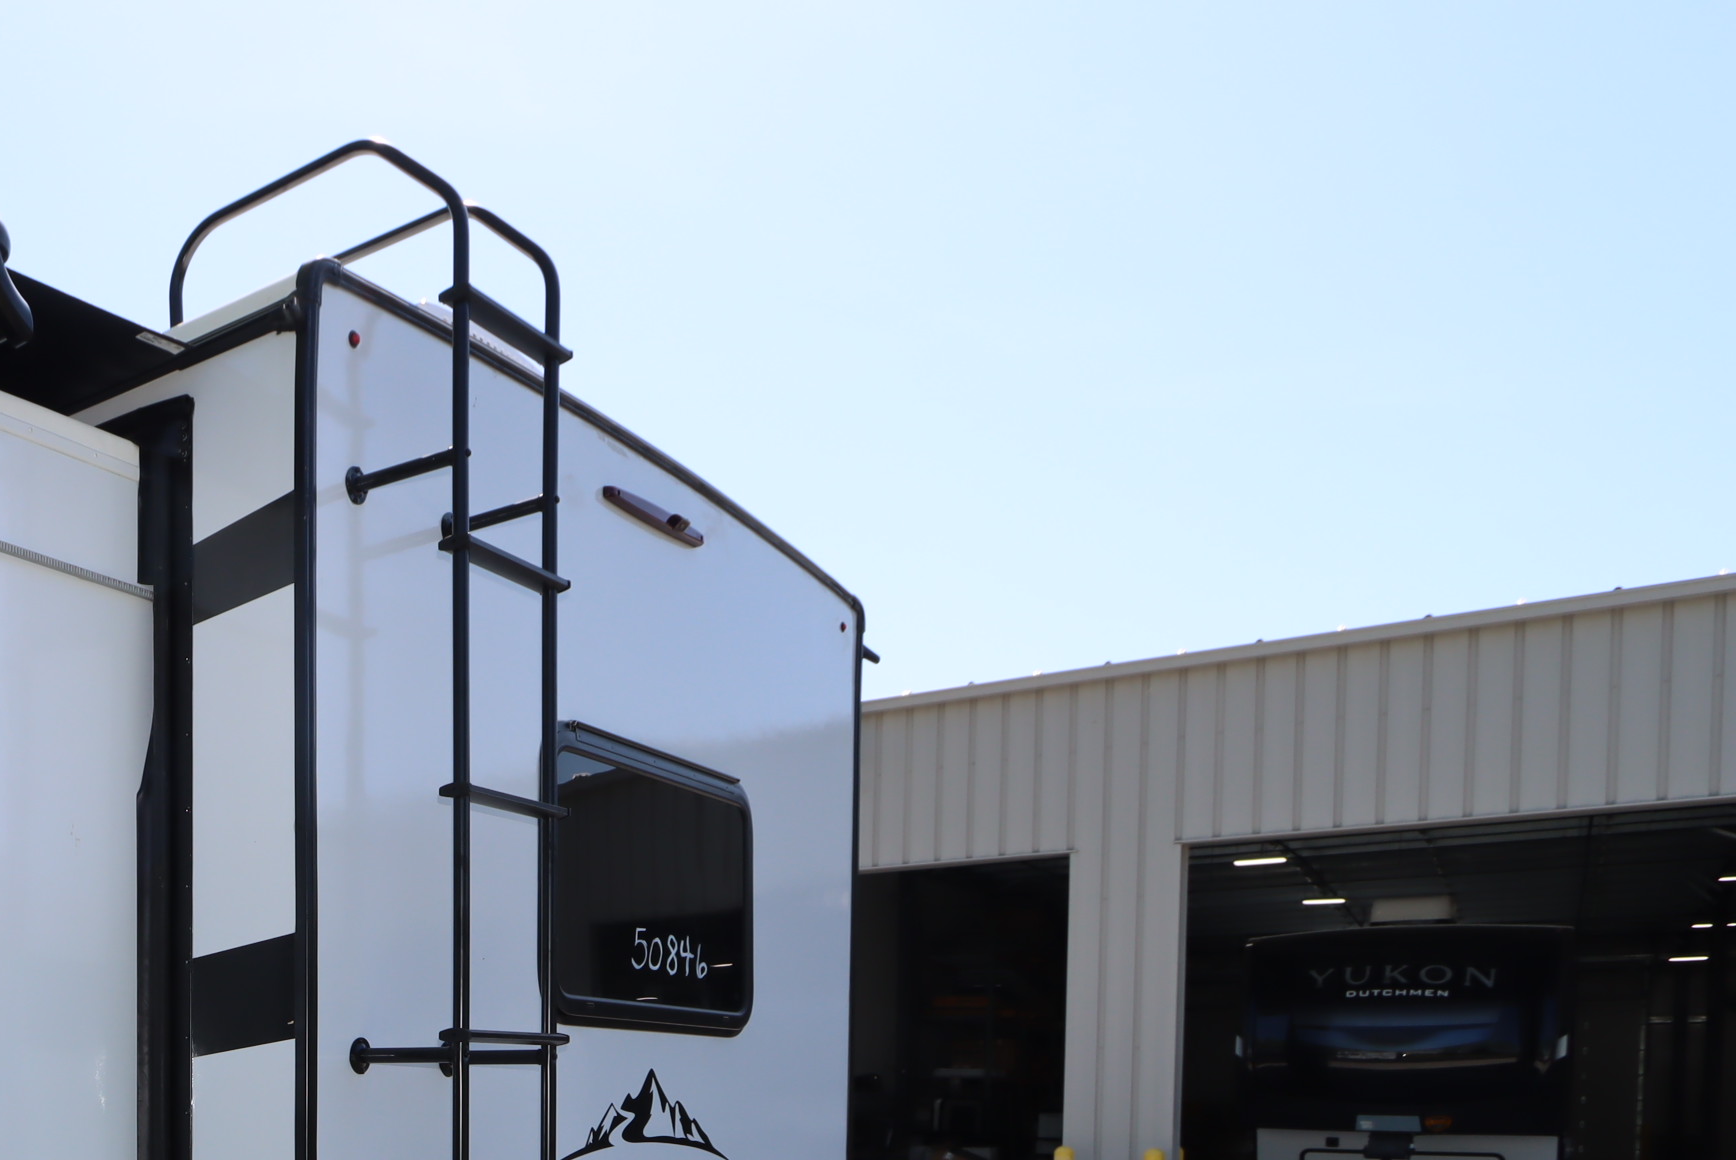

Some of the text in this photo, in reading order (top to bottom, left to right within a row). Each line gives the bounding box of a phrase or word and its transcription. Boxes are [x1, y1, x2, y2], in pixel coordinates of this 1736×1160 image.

[631, 927, 708, 979] 50846
[1309, 964, 1496, 988] YUKON
[1345, 989, 1450, 998] DUTCHMEN
